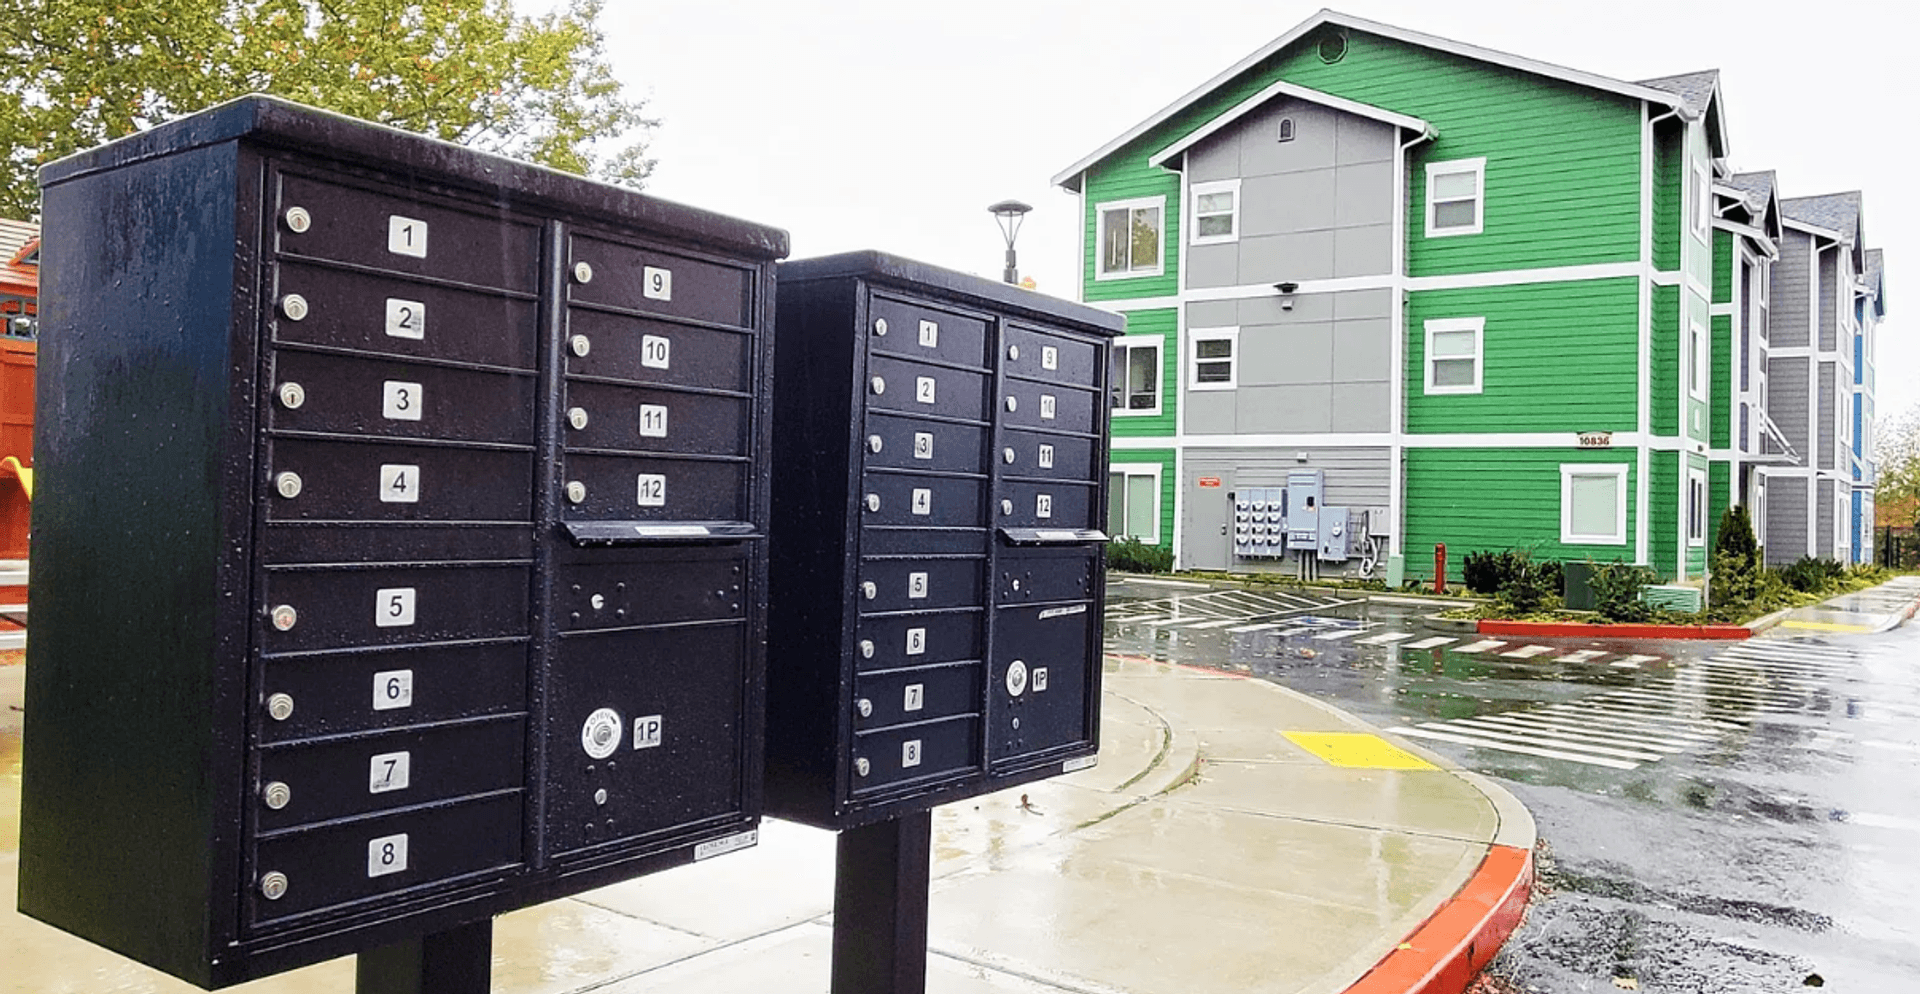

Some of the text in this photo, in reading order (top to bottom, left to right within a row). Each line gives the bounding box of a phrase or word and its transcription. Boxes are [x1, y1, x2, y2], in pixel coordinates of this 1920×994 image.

[403, 225, 413, 247] 1
[652, 273, 663, 293] 9
[398, 306, 412, 329] 2
[925, 325, 931, 342] 1
[647, 340, 666, 361] 10
[922, 381, 930, 398] 2
[396, 388, 409, 411] 3
[644, 410, 662, 430] 11
[919, 437, 927, 454] 3
[1579, 435, 1610, 446] 10836
[1041, 449, 1051, 464] 11
[392, 471, 407, 493] 4
[641, 480, 662, 499] 12
[917, 493, 925, 509] 4
[1038, 498, 1050, 513] 12
[914, 577, 922, 592] 5
[389, 595, 403, 617] 5
[912, 632, 919, 649] 6
[1034, 671, 1047, 686] 1P
[386, 677, 400, 700] 6
[910, 688, 918, 705] 7
[637, 720, 659, 741] 1P
[908, 744, 916, 761] 8
[383, 759, 397, 783] 7
[381, 842, 395, 866] 8
